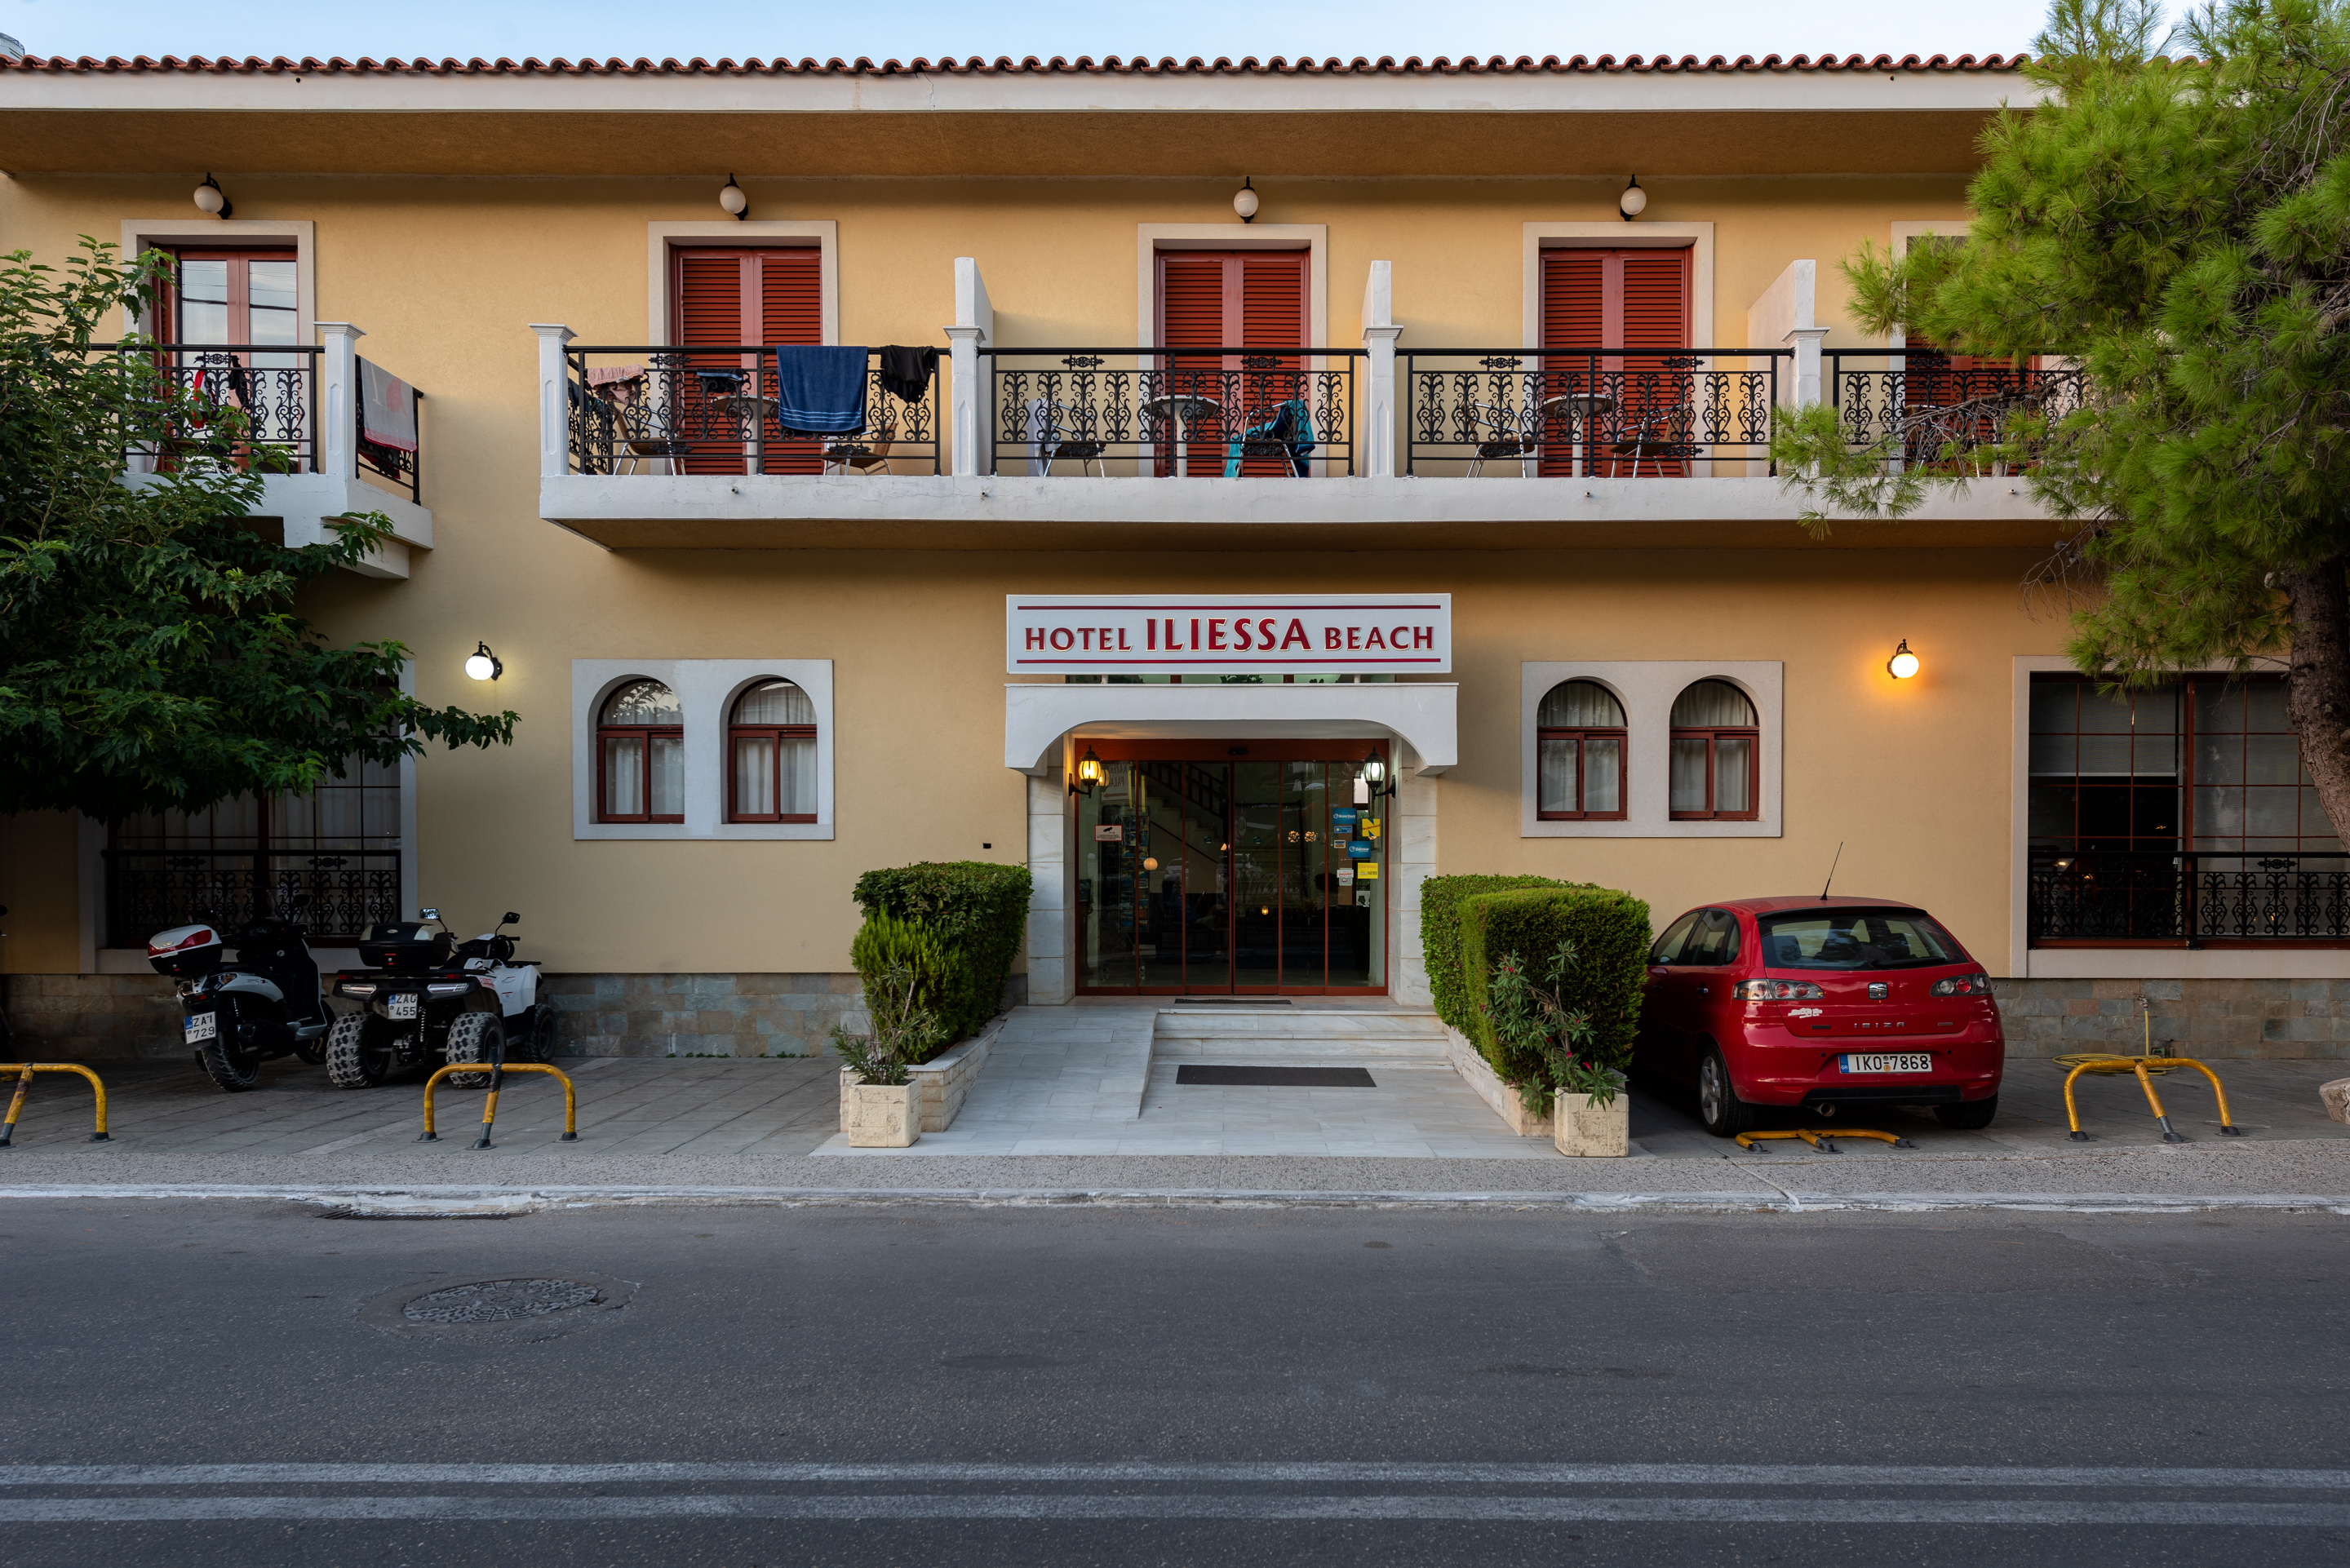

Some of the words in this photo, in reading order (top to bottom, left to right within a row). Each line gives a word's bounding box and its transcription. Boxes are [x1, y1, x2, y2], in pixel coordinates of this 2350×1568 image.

[1024, 627, 1133, 652] HOTEL
[1145, 617, 1313, 652] ILIESSA
[1324, 625, 1434, 651] BEACH
[396, 1006, 416, 1017] 455
[193, 1026, 215, 1039] 729
